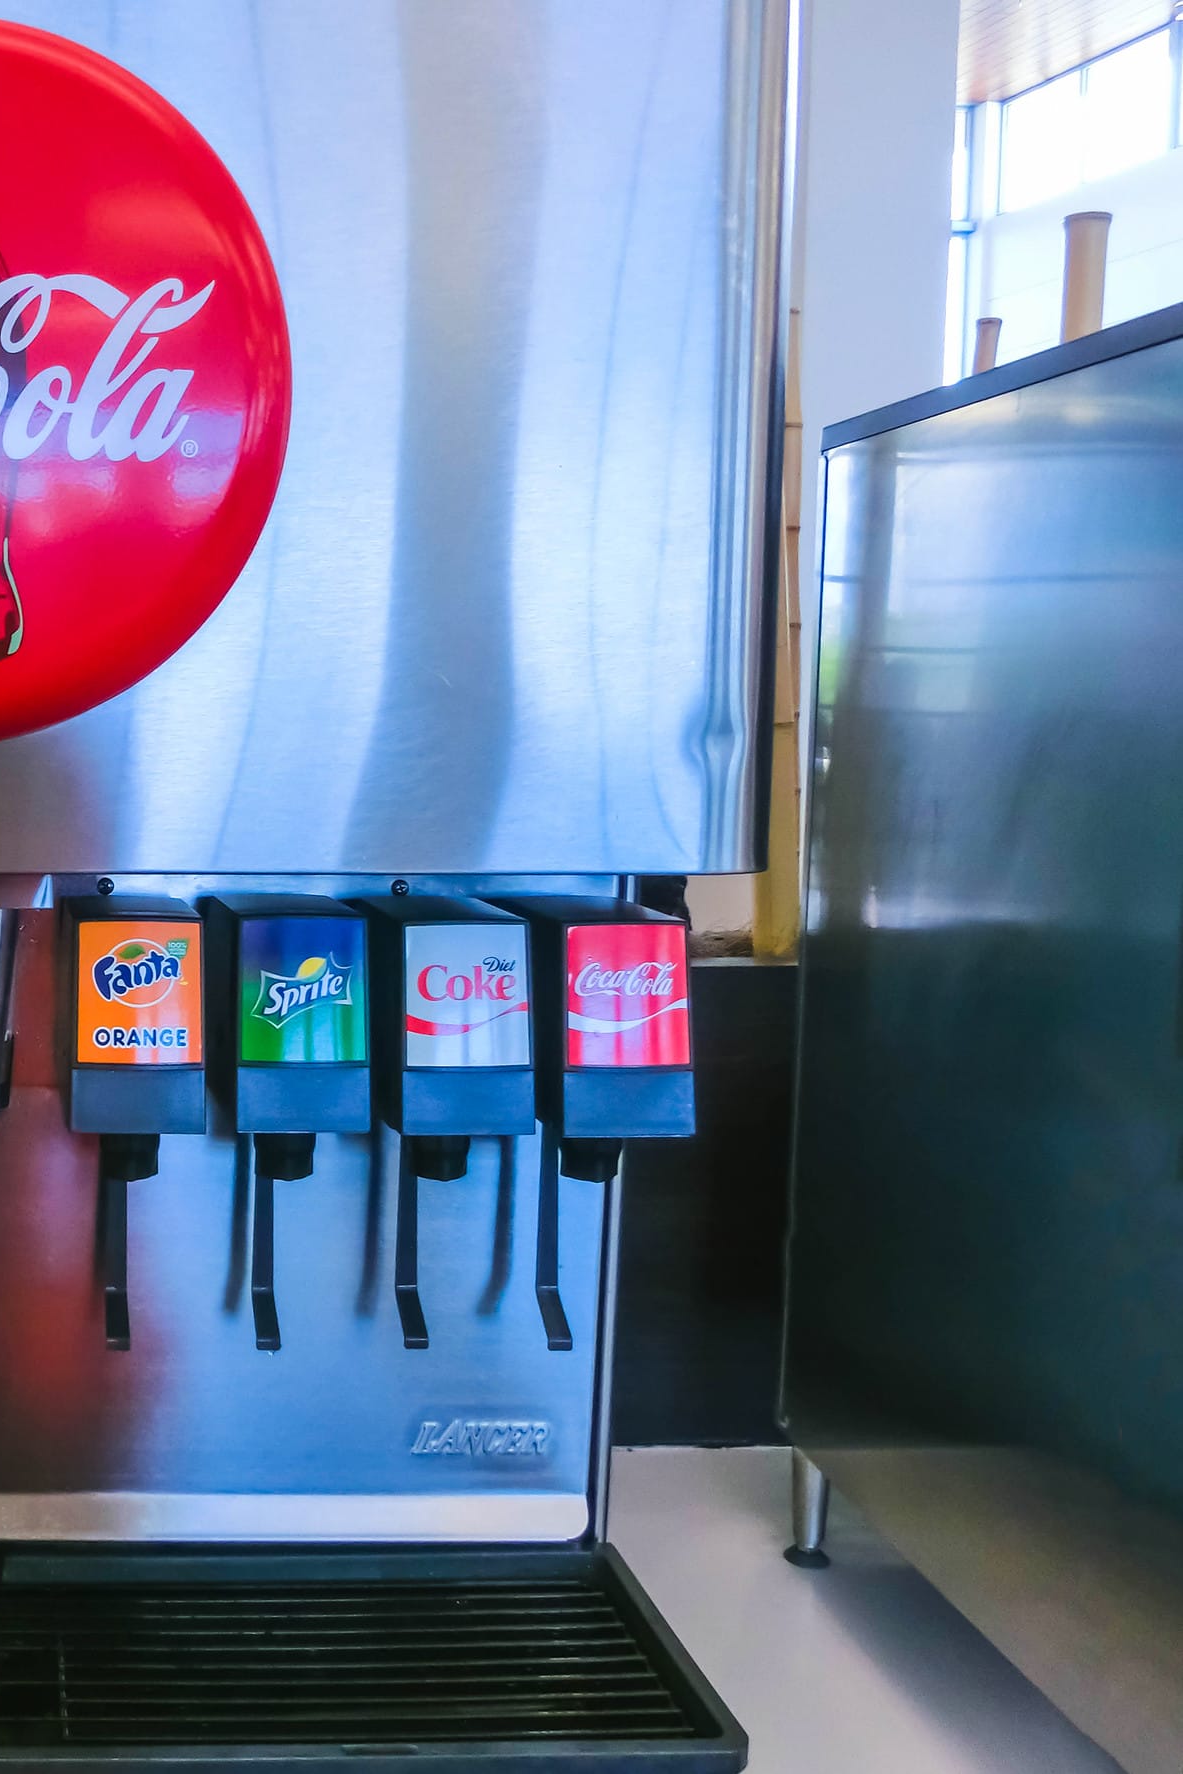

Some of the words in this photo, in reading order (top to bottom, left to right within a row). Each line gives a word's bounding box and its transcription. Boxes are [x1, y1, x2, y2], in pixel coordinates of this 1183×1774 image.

[93, 950, 181, 1001] Fanta
[482, 956, 516, 972] Diet
[574, 961, 677, 996] Coca-Cola
[263, 967, 344, 1016] Sprite
[417, 964, 516, 1002] Coke
[94, 1027, 188, 1048] ORANGE
[411, 1420, 550, 1455] LANCER
